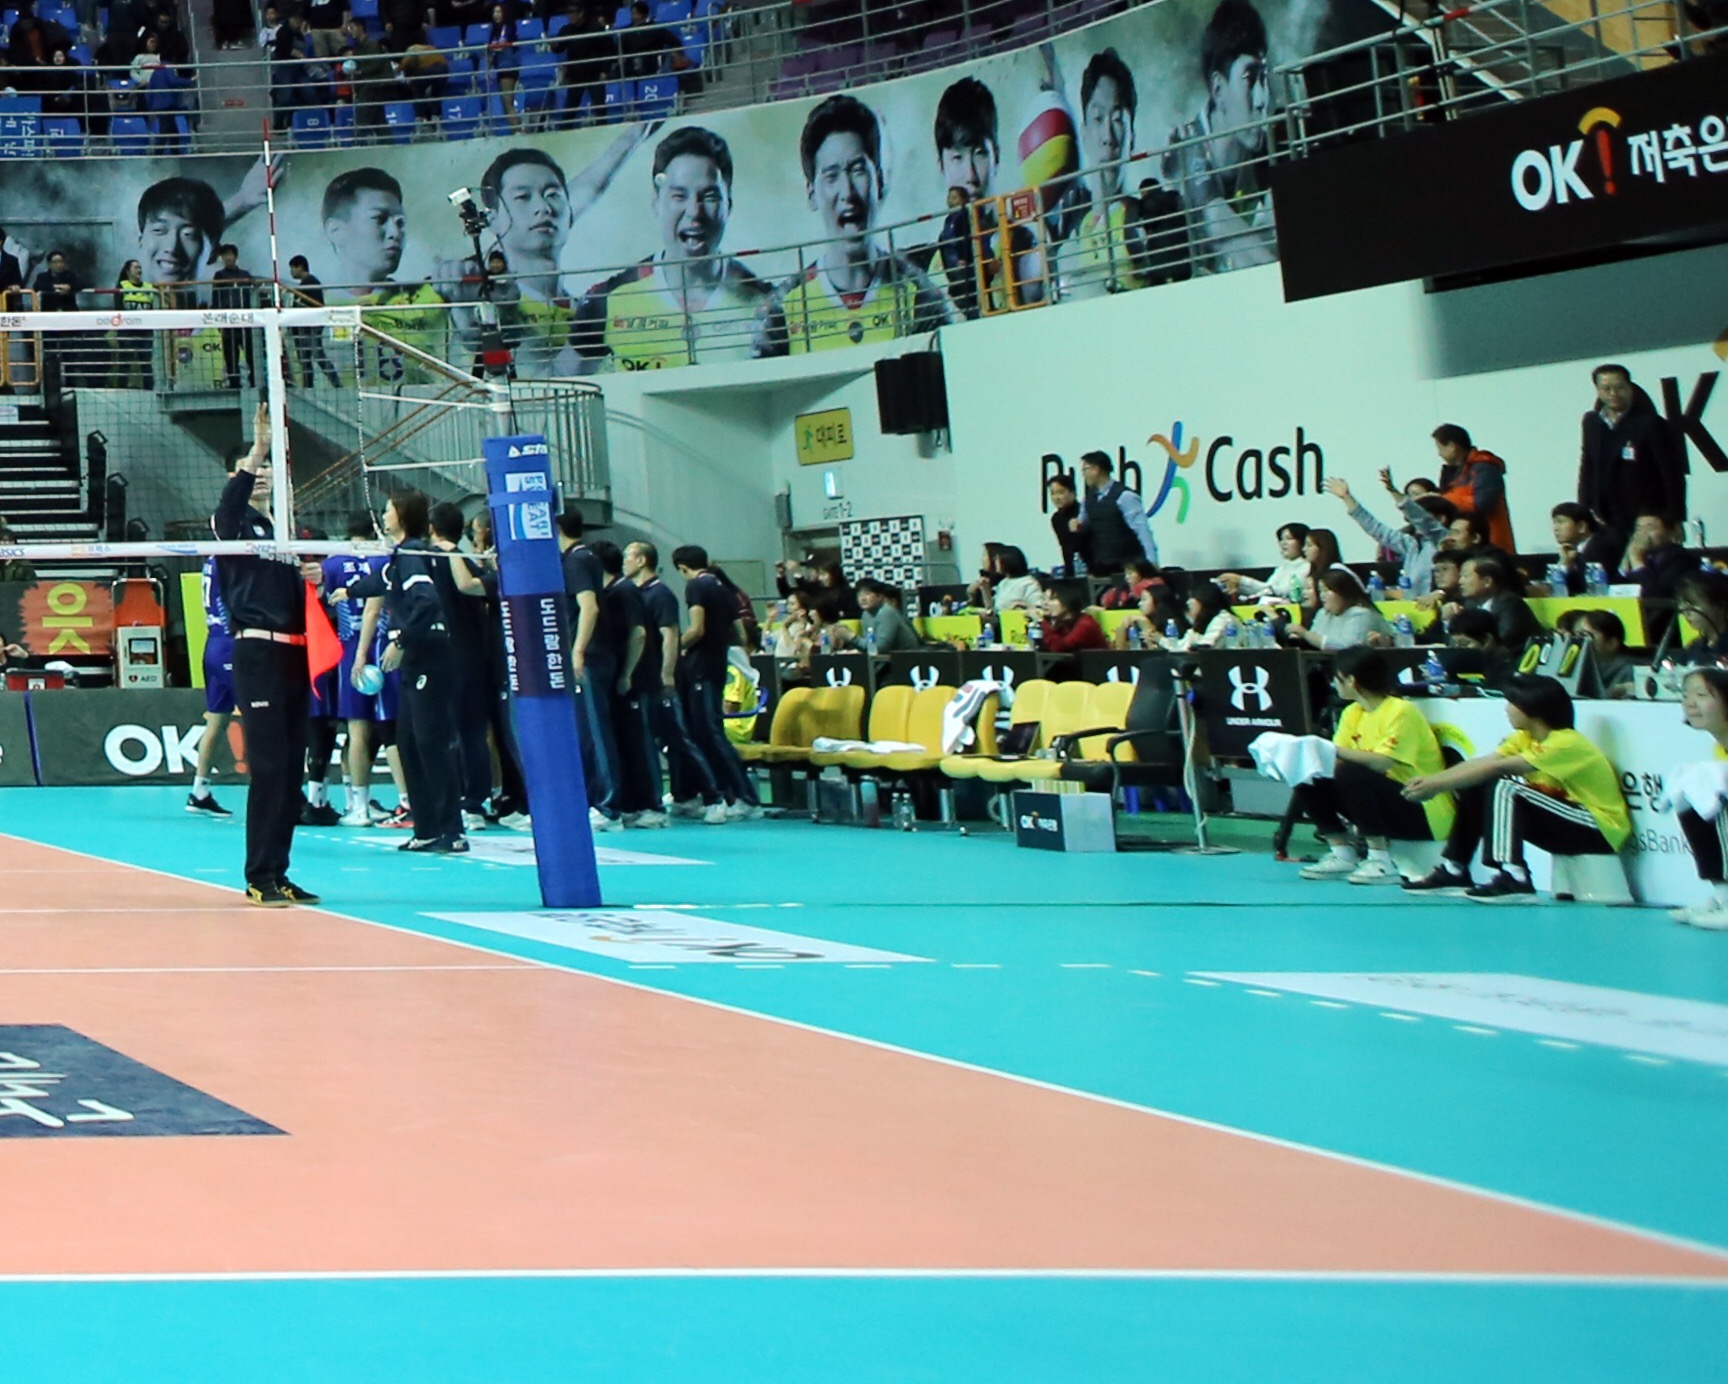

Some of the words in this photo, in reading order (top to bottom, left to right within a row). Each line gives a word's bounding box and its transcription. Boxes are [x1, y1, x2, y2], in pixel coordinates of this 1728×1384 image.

[815, 422, 848, 446] 대피로
[1205, 427, 1324, 505] Cash
[139, 674, 158, 684] AED
[1225, 718, 1252, 727] UNDER
[1254, 717, 1283, 727] ARMOUR
